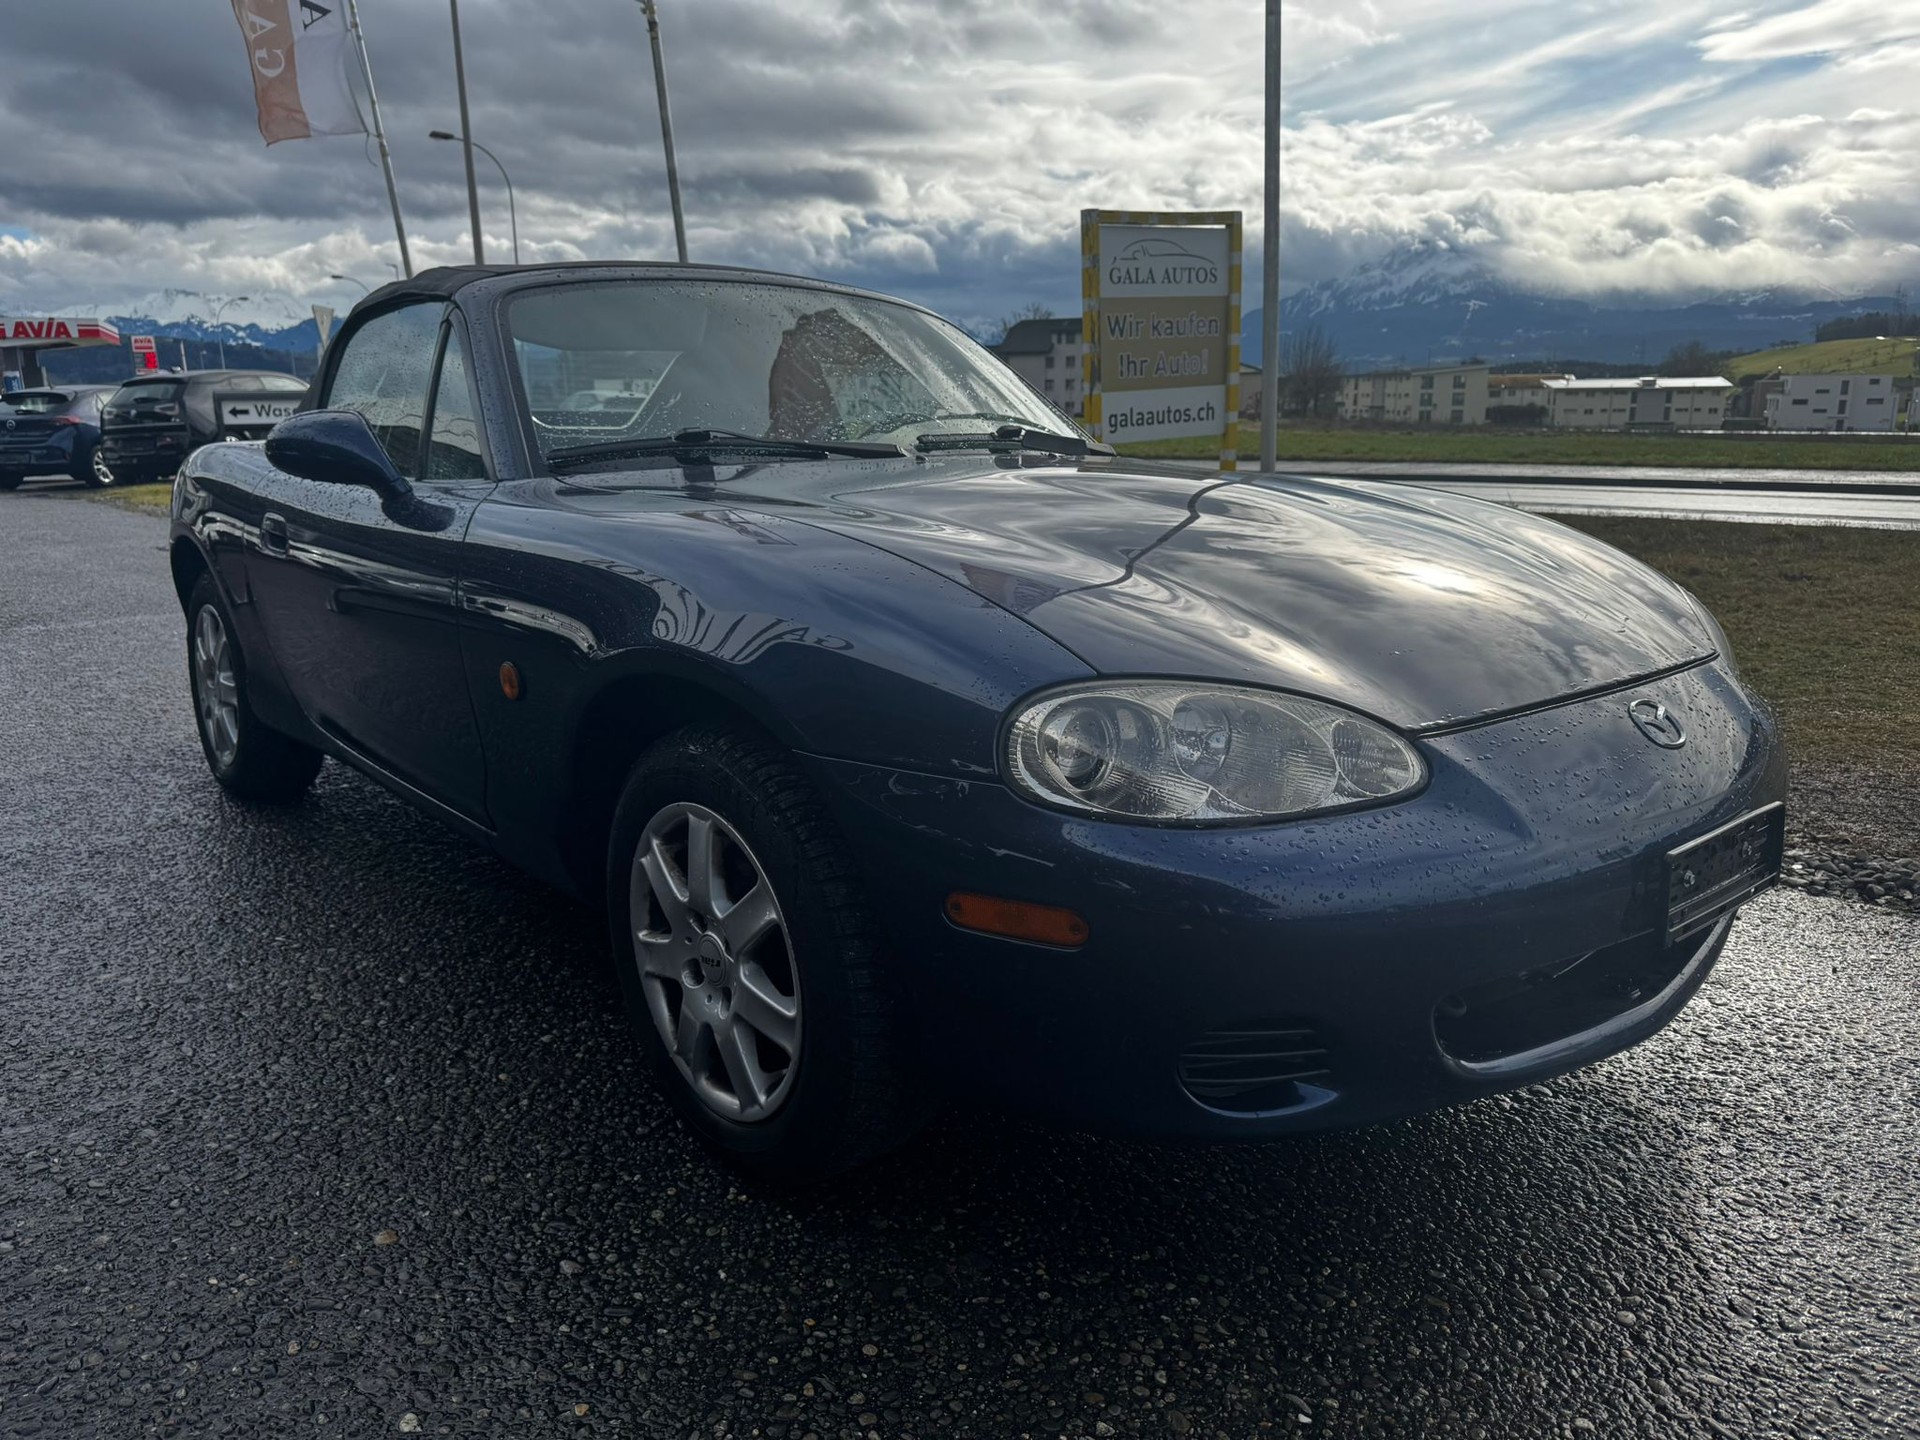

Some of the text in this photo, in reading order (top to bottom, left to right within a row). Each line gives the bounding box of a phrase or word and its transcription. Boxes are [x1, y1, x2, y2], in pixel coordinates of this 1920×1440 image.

[1109, 266, 1218, 285] GALA AUTOS
[13, 317, 72, 338] AVIA
[1106, 311, 1220, 338] Wir kaufen
[1119, 350, 1209, 378] Ihr Auto!
[1108, 401, 1215, 434] galaautos.ch
